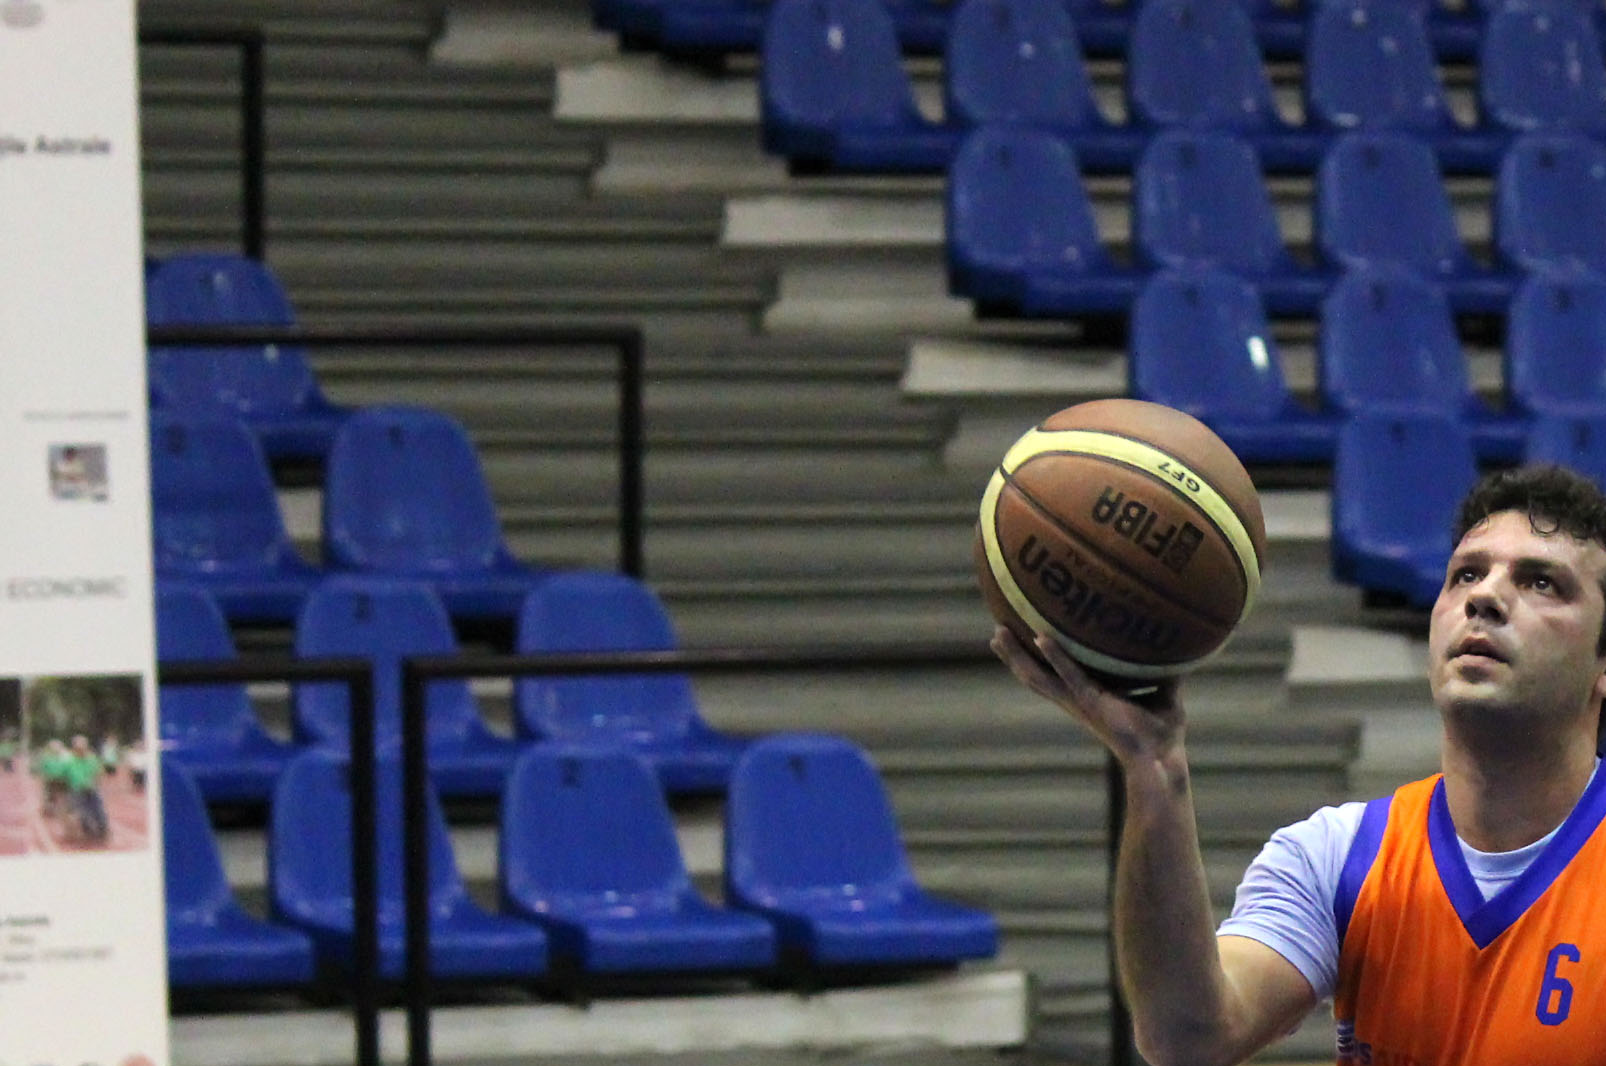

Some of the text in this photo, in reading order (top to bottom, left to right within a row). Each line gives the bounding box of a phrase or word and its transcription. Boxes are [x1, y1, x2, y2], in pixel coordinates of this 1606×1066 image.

[1158, 461, 1201, 493] GF7
[1092, 486, 1178, 558] FIBA
[1017, 533, 1185, 647] molten
[1535, 942, 1581, 1026] 6
